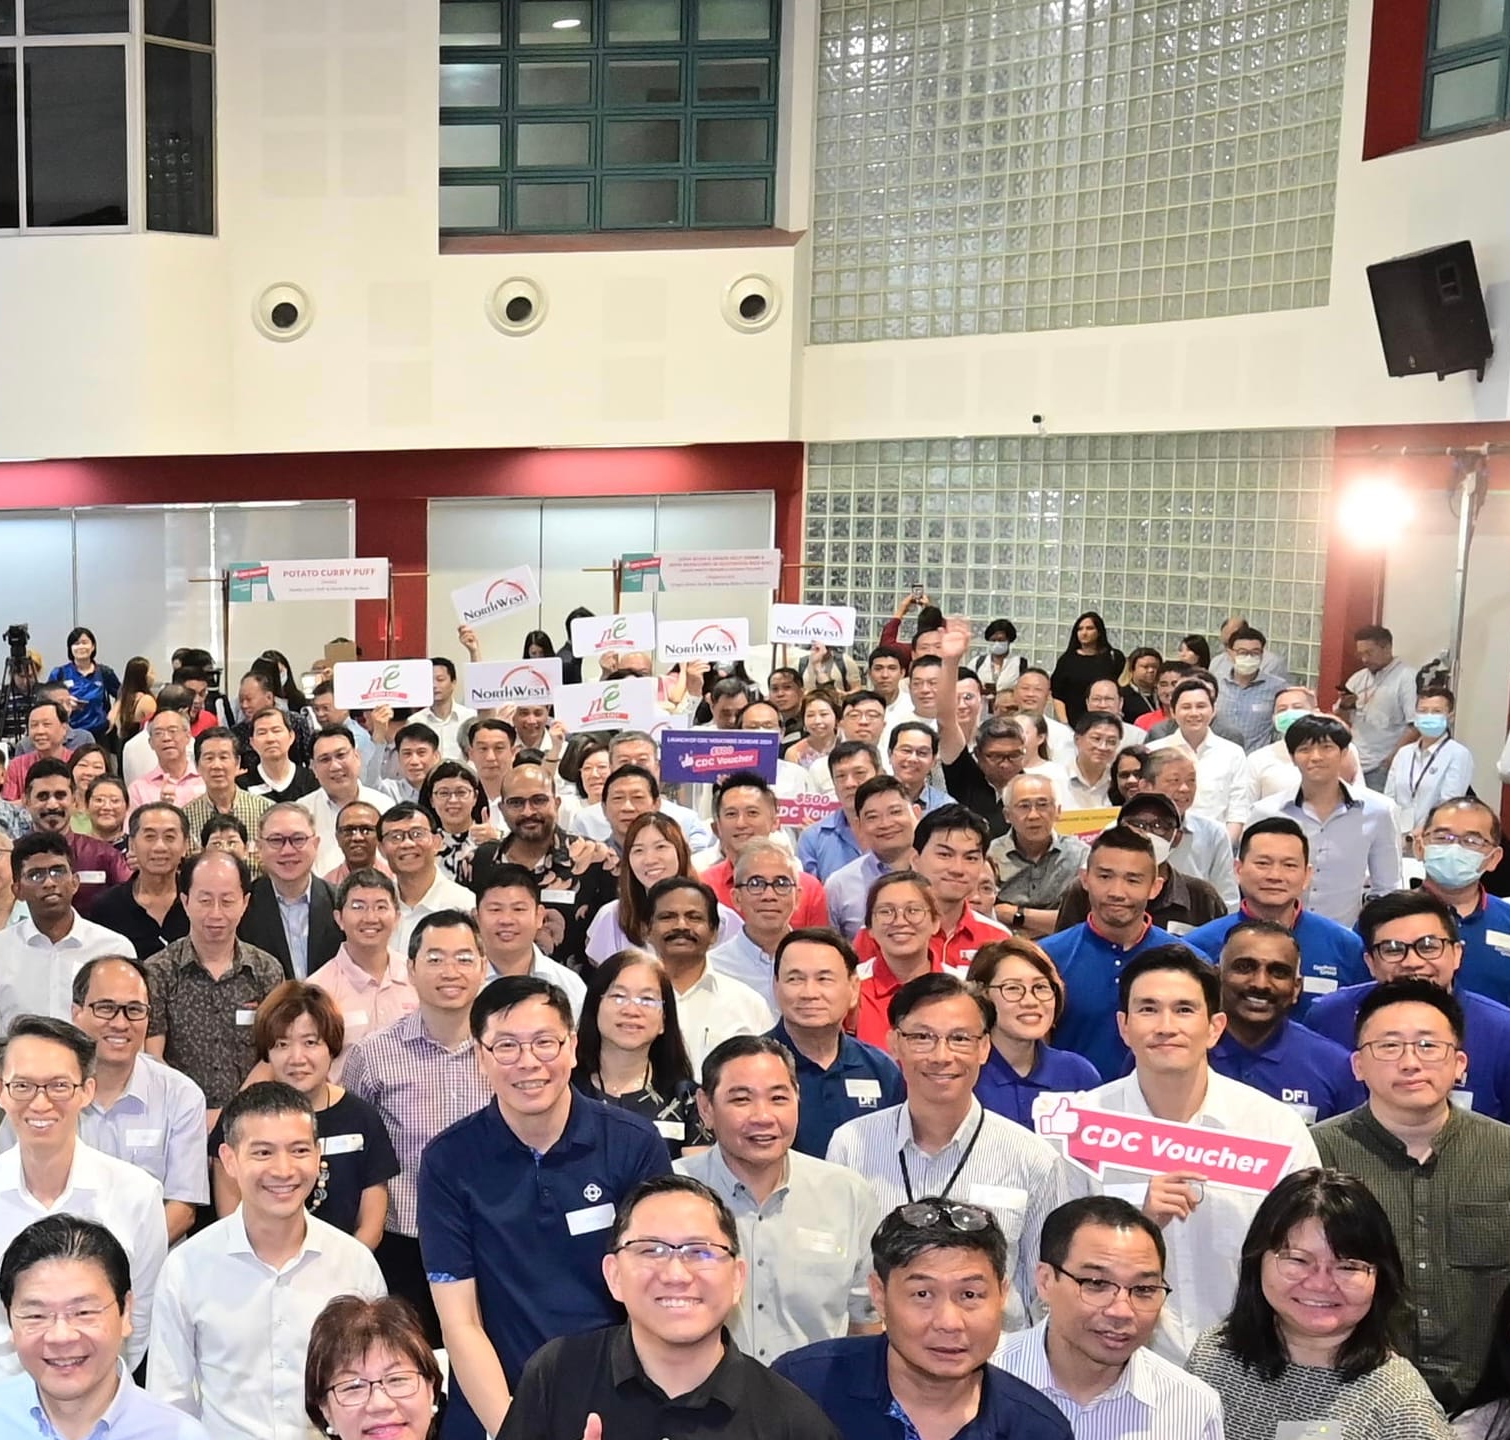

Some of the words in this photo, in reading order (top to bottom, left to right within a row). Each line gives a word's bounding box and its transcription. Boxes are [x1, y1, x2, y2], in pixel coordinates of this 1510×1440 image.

[695, 756, 716, 767] CDC
[717, 754, 754, 765] Voucher
[796, 792, 830, 805] $500
[1080, 1125, 1143, 1152] CDC
[1150, 1135, 1269, 1175] Voucher
